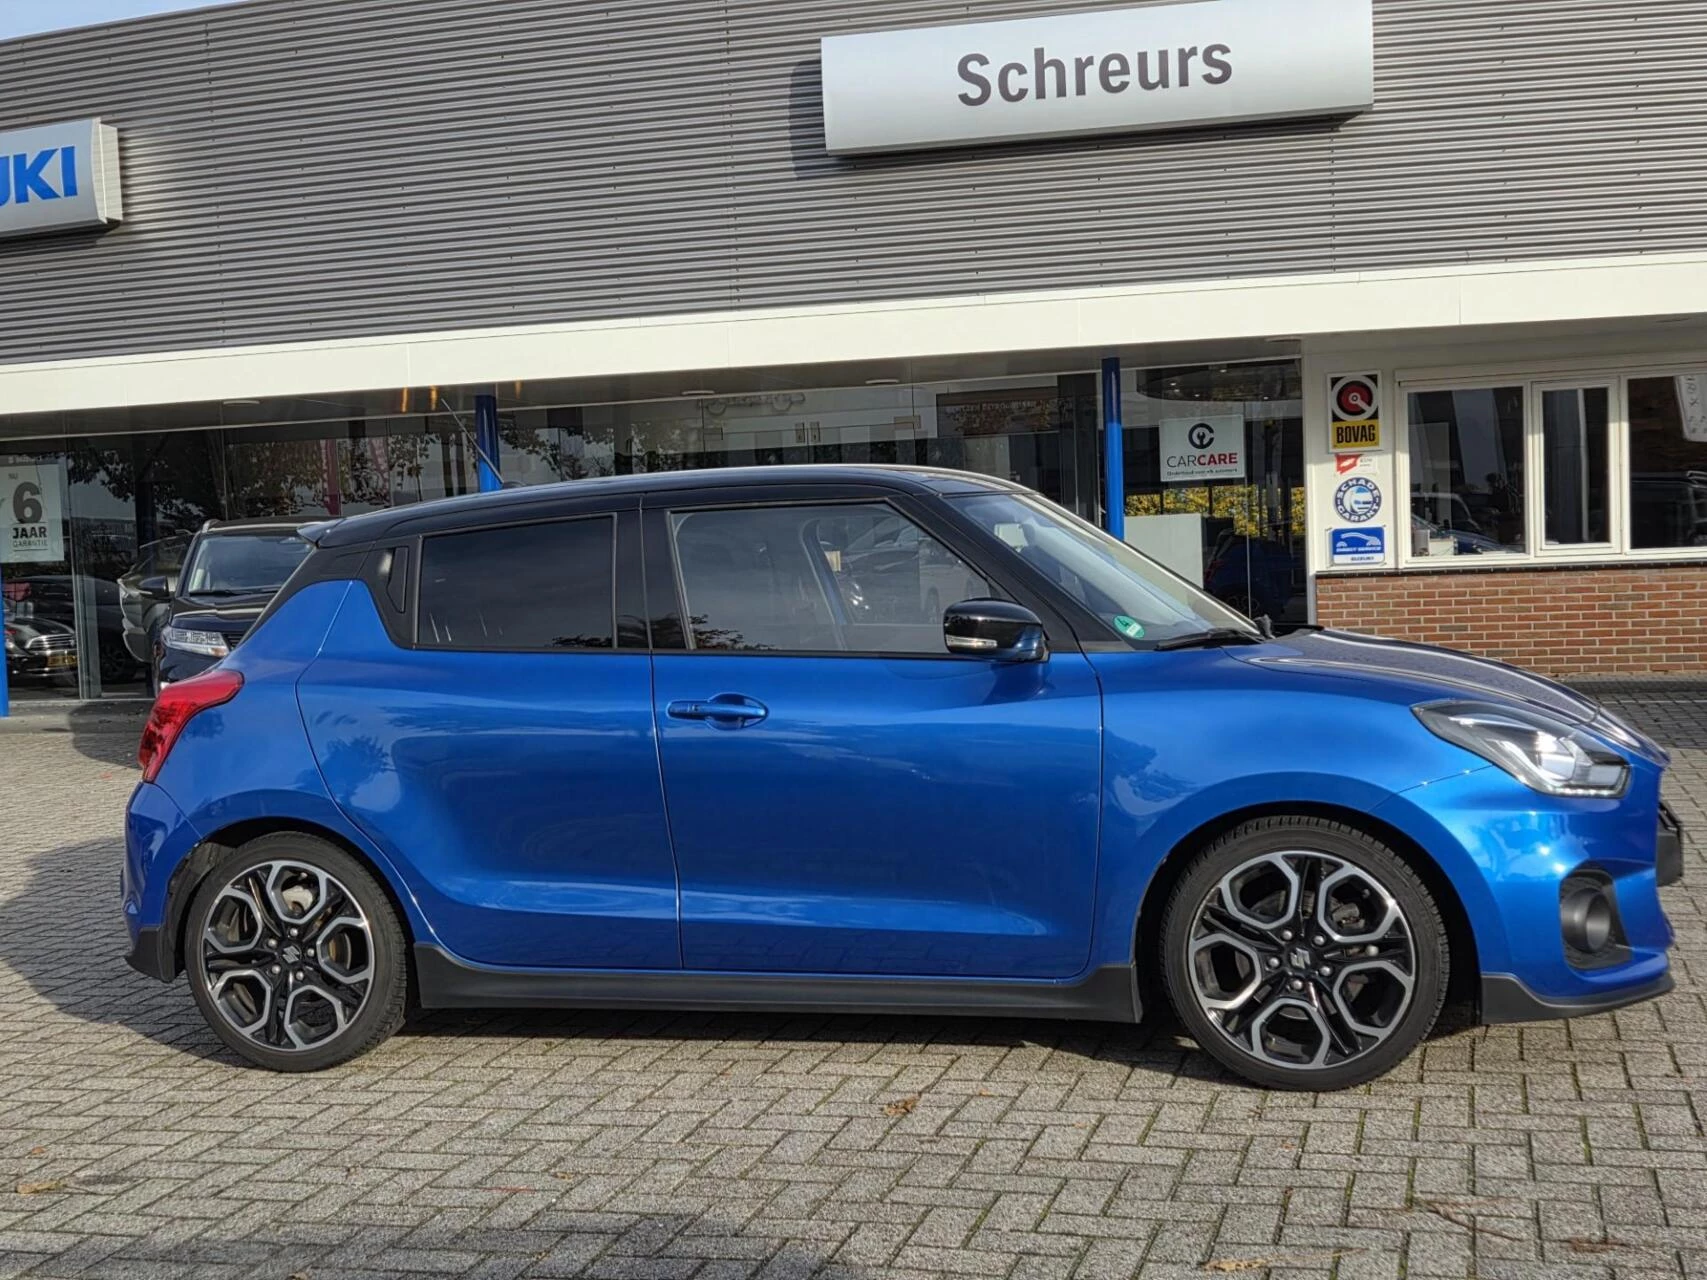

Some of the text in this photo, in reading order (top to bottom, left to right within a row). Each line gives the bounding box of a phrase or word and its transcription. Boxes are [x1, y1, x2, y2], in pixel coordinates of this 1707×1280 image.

[957, 43, 1232, 106] Schreurs
[0, 146, 78, 207] KI
[1336, 424, 1376, 443] BOVAG
[1166, 452, 1238, 468] CARCARE
[1336, 479, 1381, 499] SCHADE
[13, 481, 43, 524] 6
[1337, 503, 1380, 521] GARANT
[12, 526, 47, 539] JAAR
